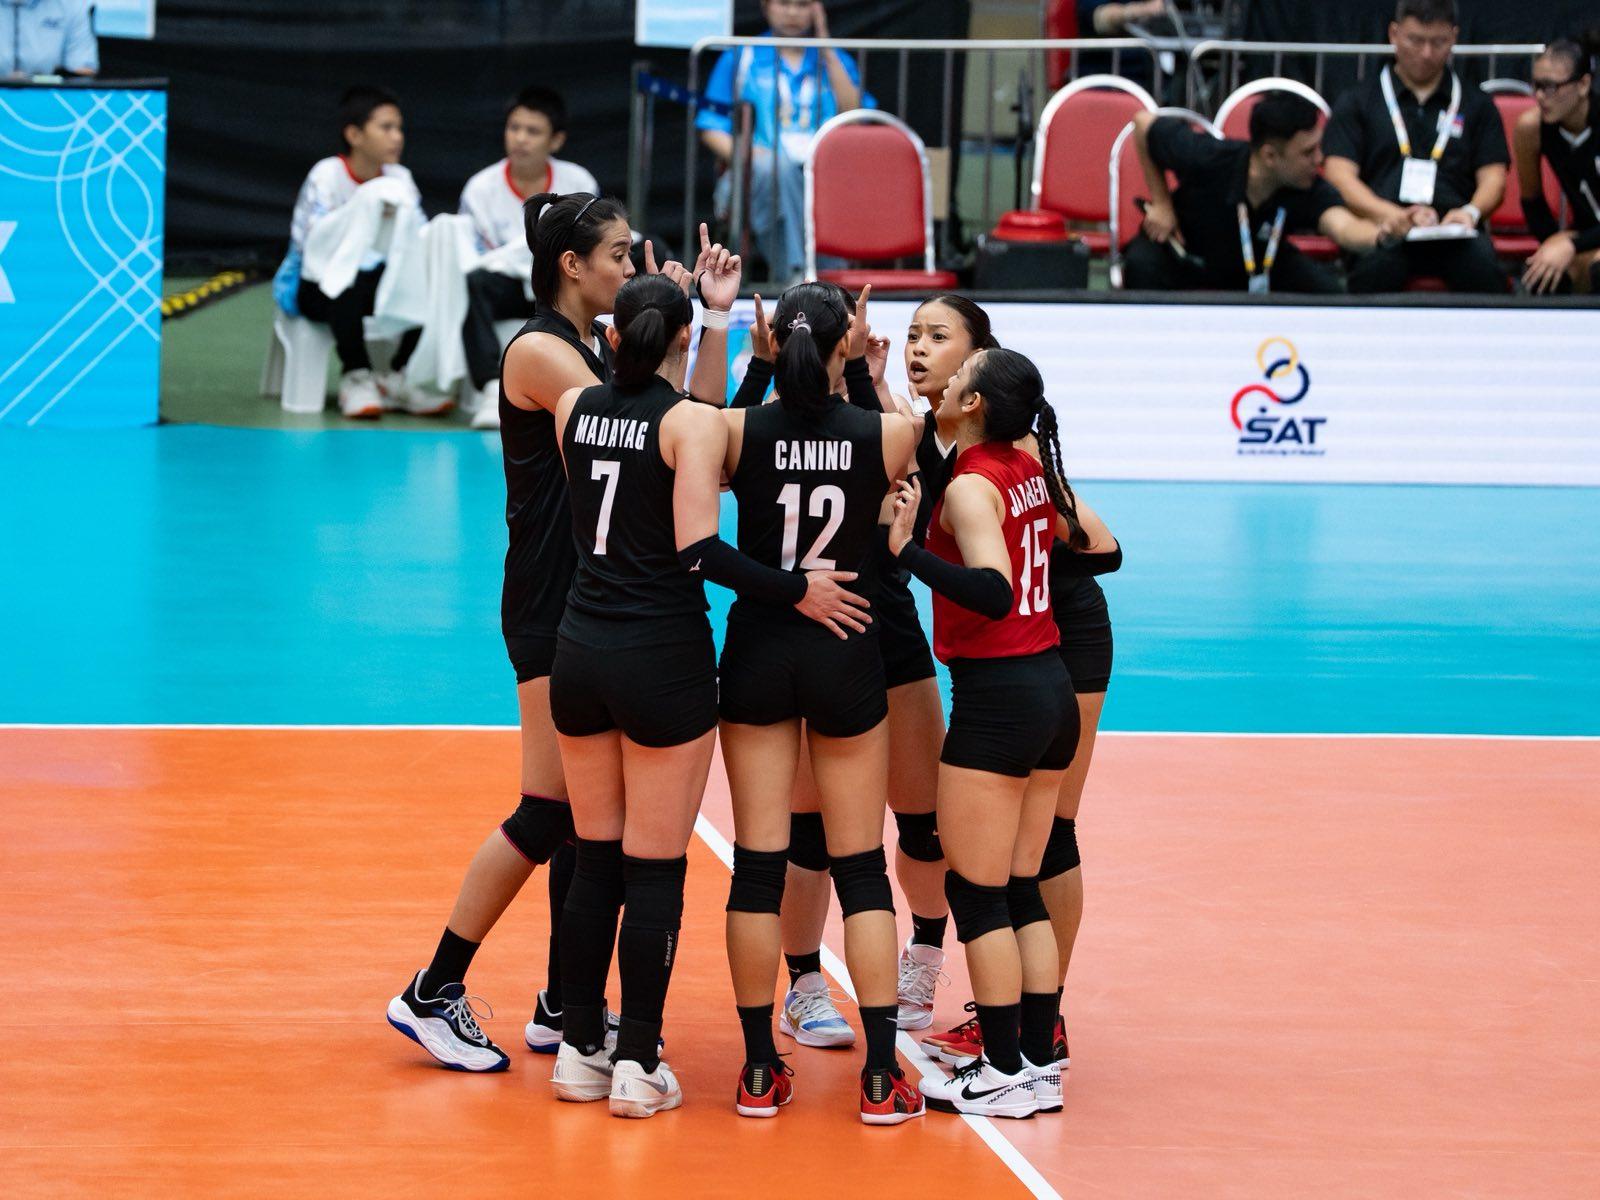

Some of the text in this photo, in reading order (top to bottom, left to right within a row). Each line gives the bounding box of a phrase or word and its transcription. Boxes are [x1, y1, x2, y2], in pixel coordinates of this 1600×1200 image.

[574, 414, 649, 450] MADAYAG
[774, 440, 853, 471] CANINO
[1238, 416, 1327, 444] SAT
[590, 459, 621, 555] 7
[776, 482, 846, 572] 12
[1018, 517, 1050, 616] 15
